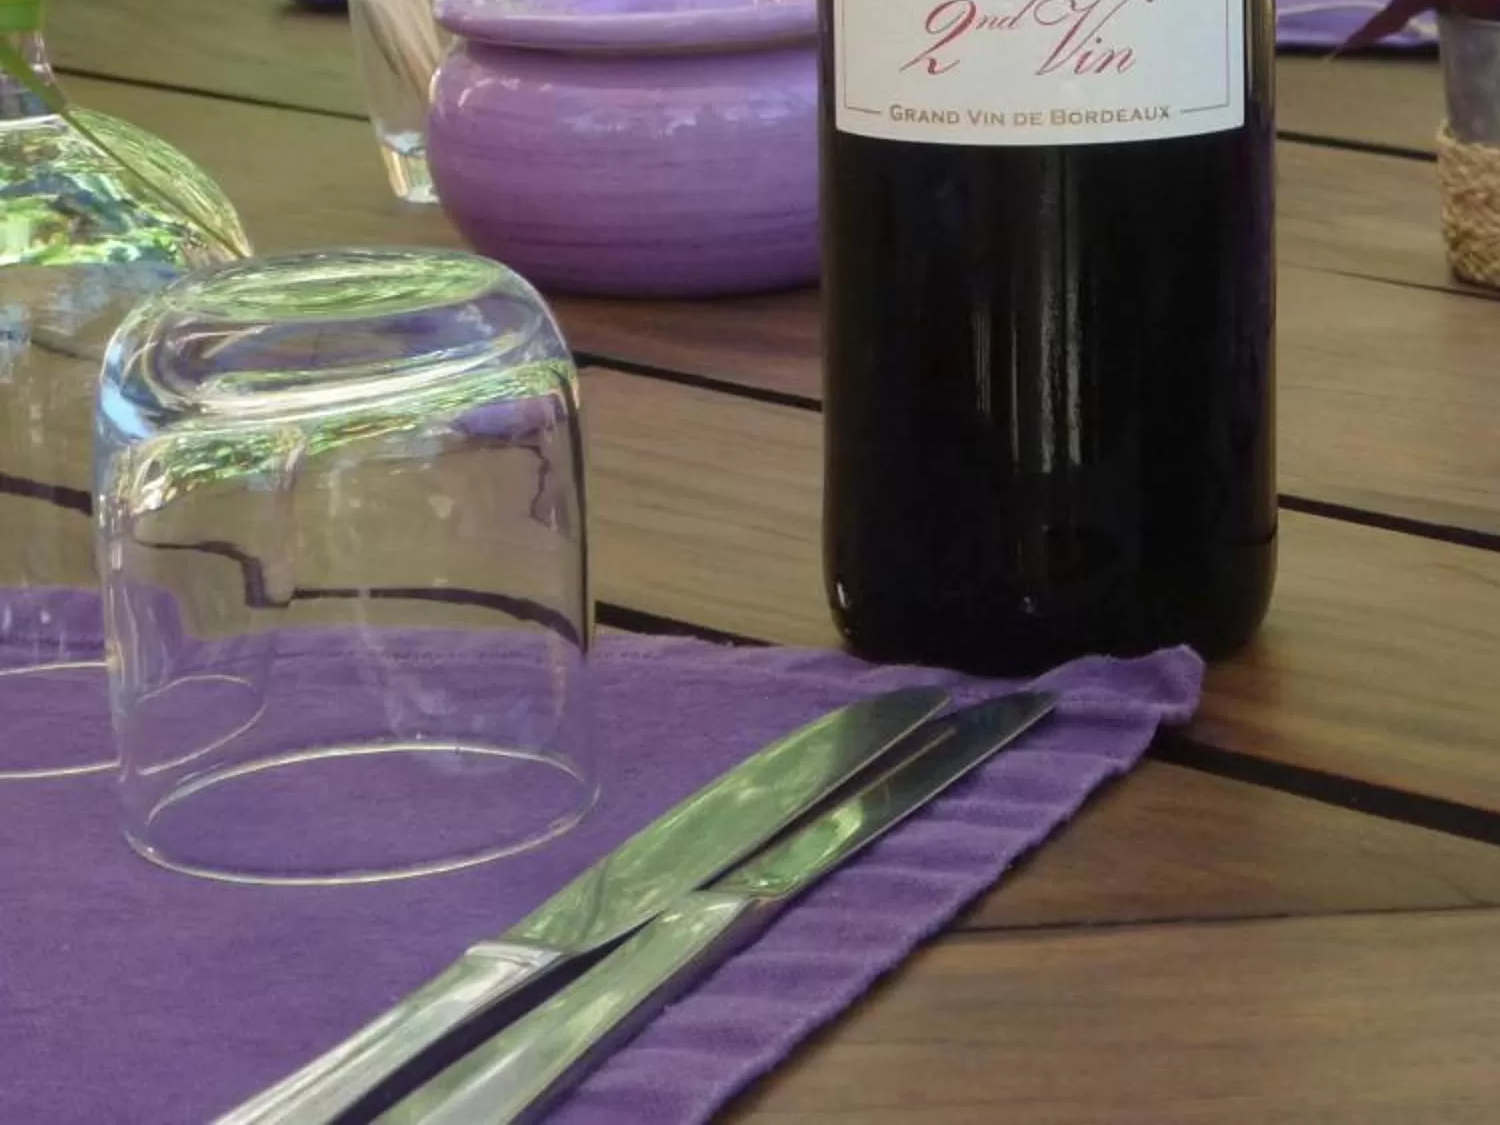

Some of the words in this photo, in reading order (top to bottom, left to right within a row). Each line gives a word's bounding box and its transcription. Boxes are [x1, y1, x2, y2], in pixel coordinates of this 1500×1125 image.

[888, 104, 960, 126] GRAND
[966, 108, 1005, 127] VIN
[1012, 111, 1043, 127] DE
[1050, 105, 1171, 127] BORDEAUX
